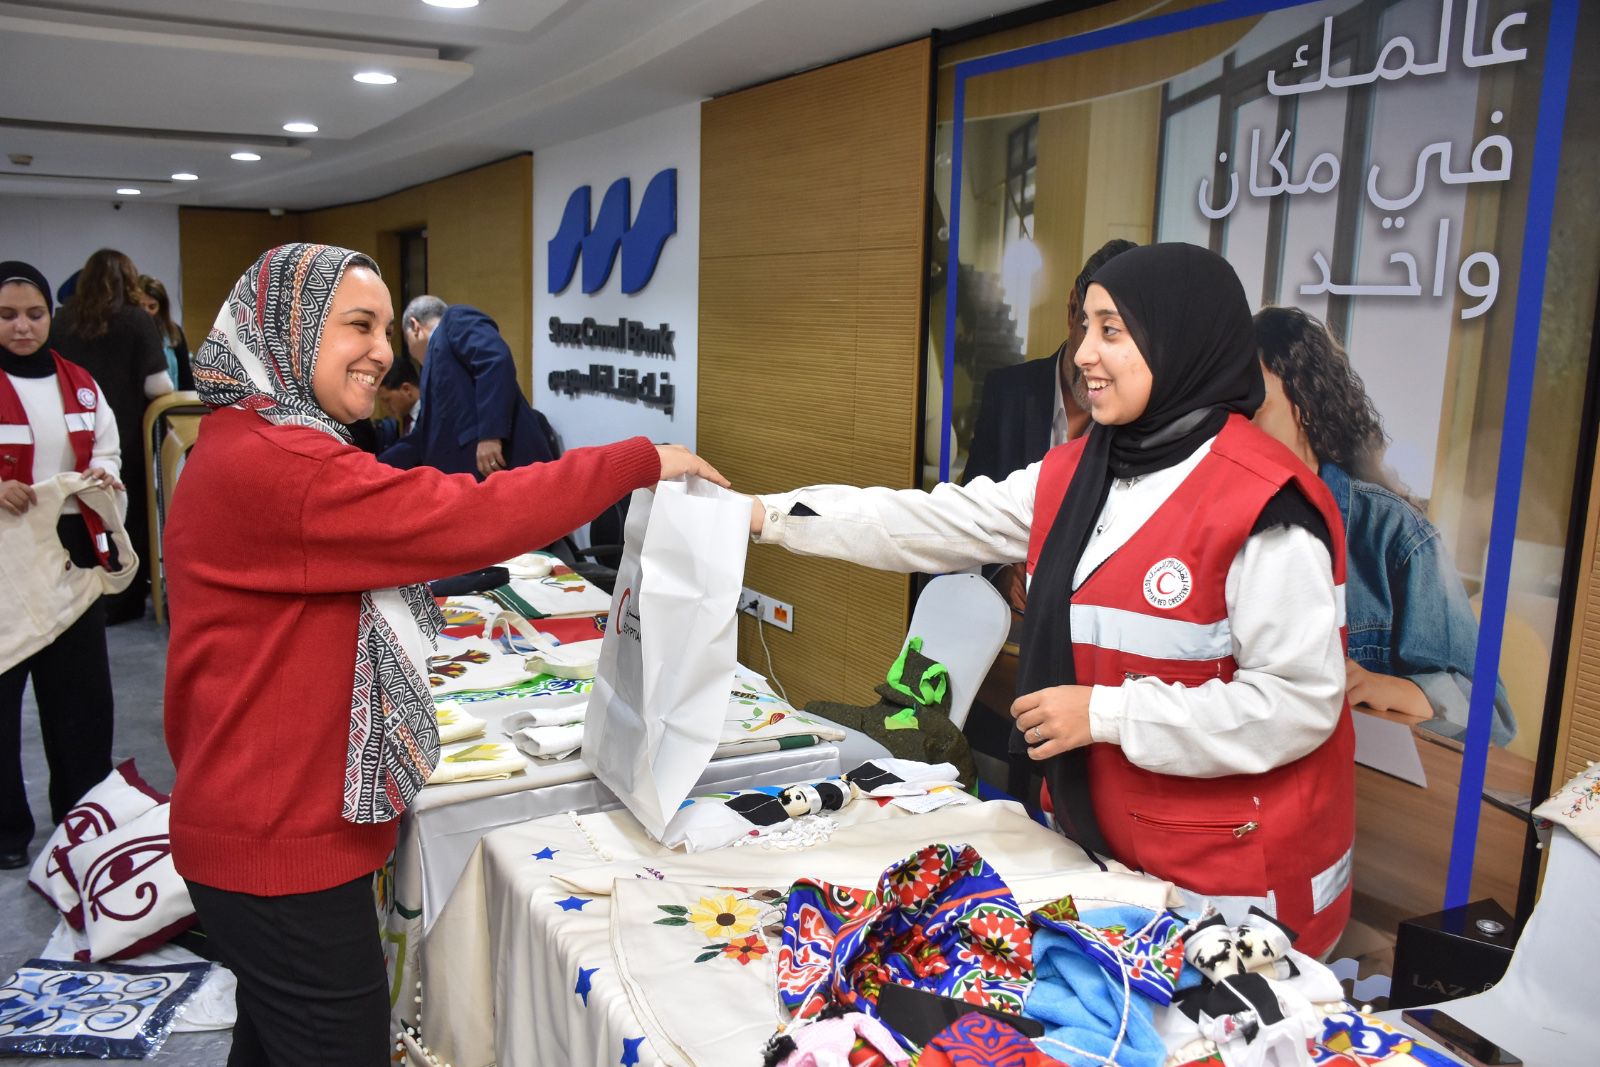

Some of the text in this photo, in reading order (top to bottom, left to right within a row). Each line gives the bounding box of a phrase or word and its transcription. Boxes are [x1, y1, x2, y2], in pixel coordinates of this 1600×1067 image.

[1267, 0, 1527, 96] عالمك
[1198, 110, 1513, 229] في مكان
[1300, 218, 1499, 320] واحد
[549, 316, 675, 359] Suez Canal Bank
